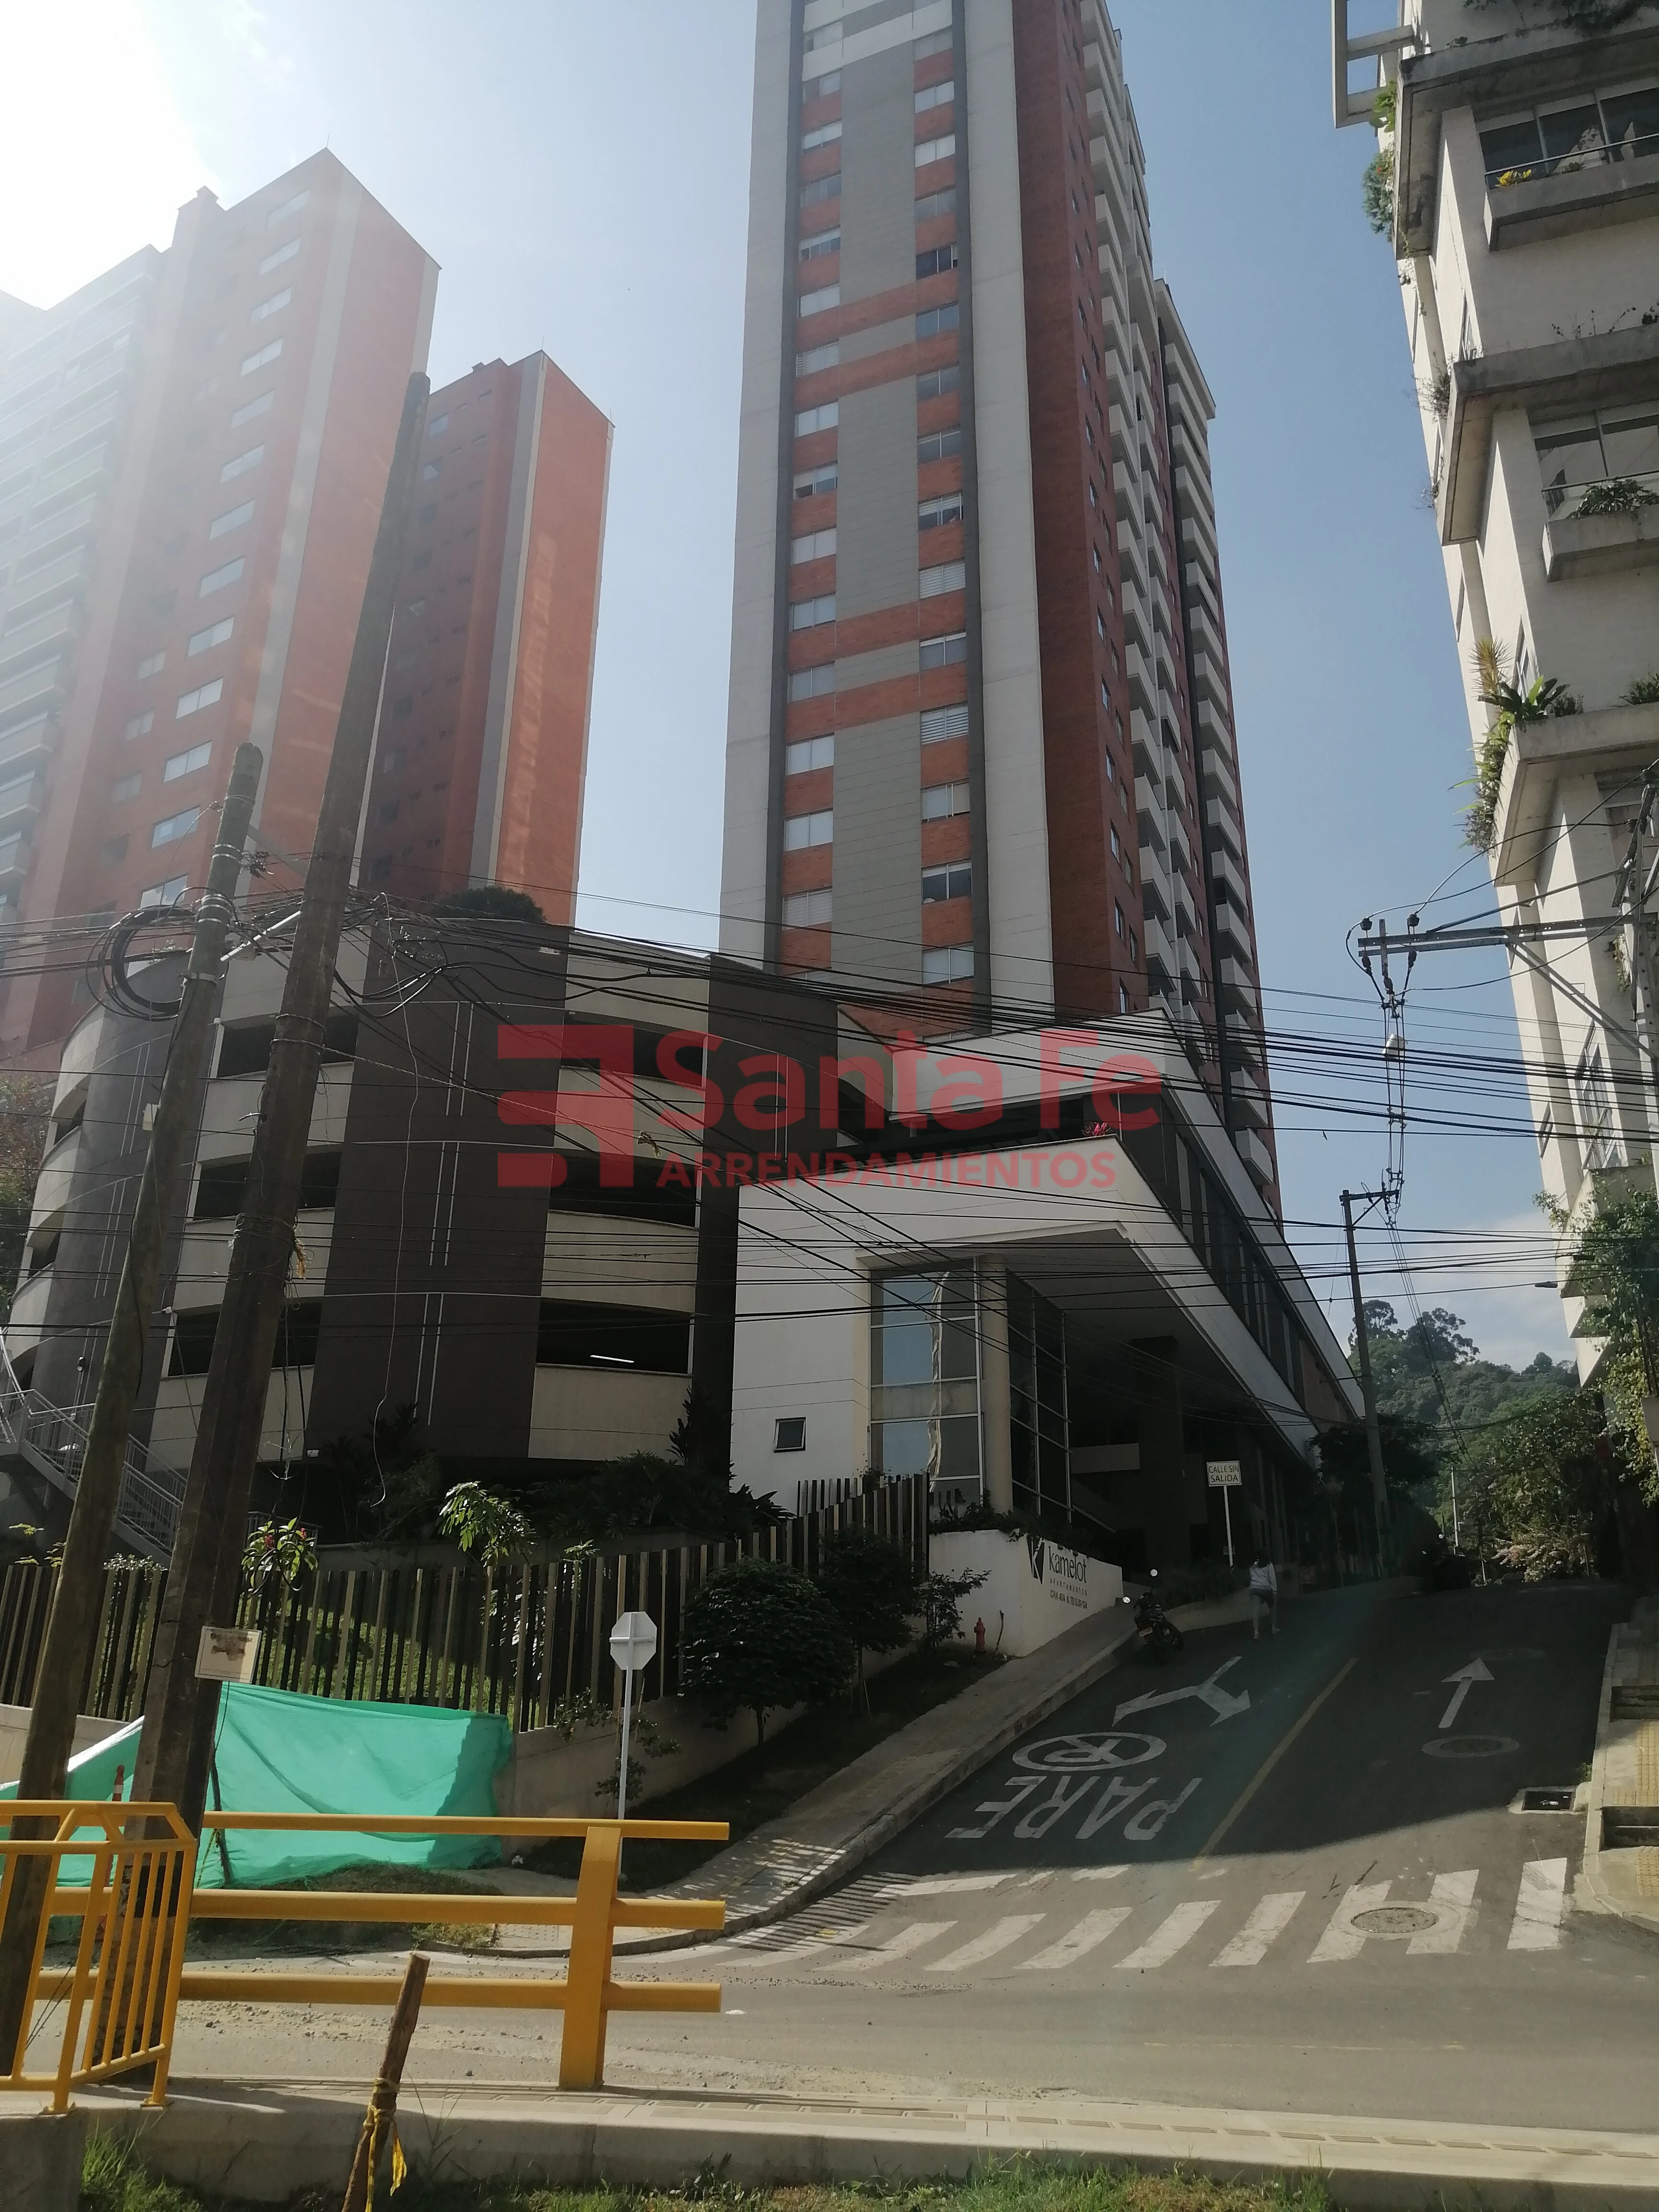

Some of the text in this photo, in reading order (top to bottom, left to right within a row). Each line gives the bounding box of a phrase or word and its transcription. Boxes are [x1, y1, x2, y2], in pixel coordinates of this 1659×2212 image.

[1211, 1474, 1238, 1482] SALIDA
[1048, 1545, 1086, 1583] kamelot
[944, 1776, 1202, 1840] PARE
